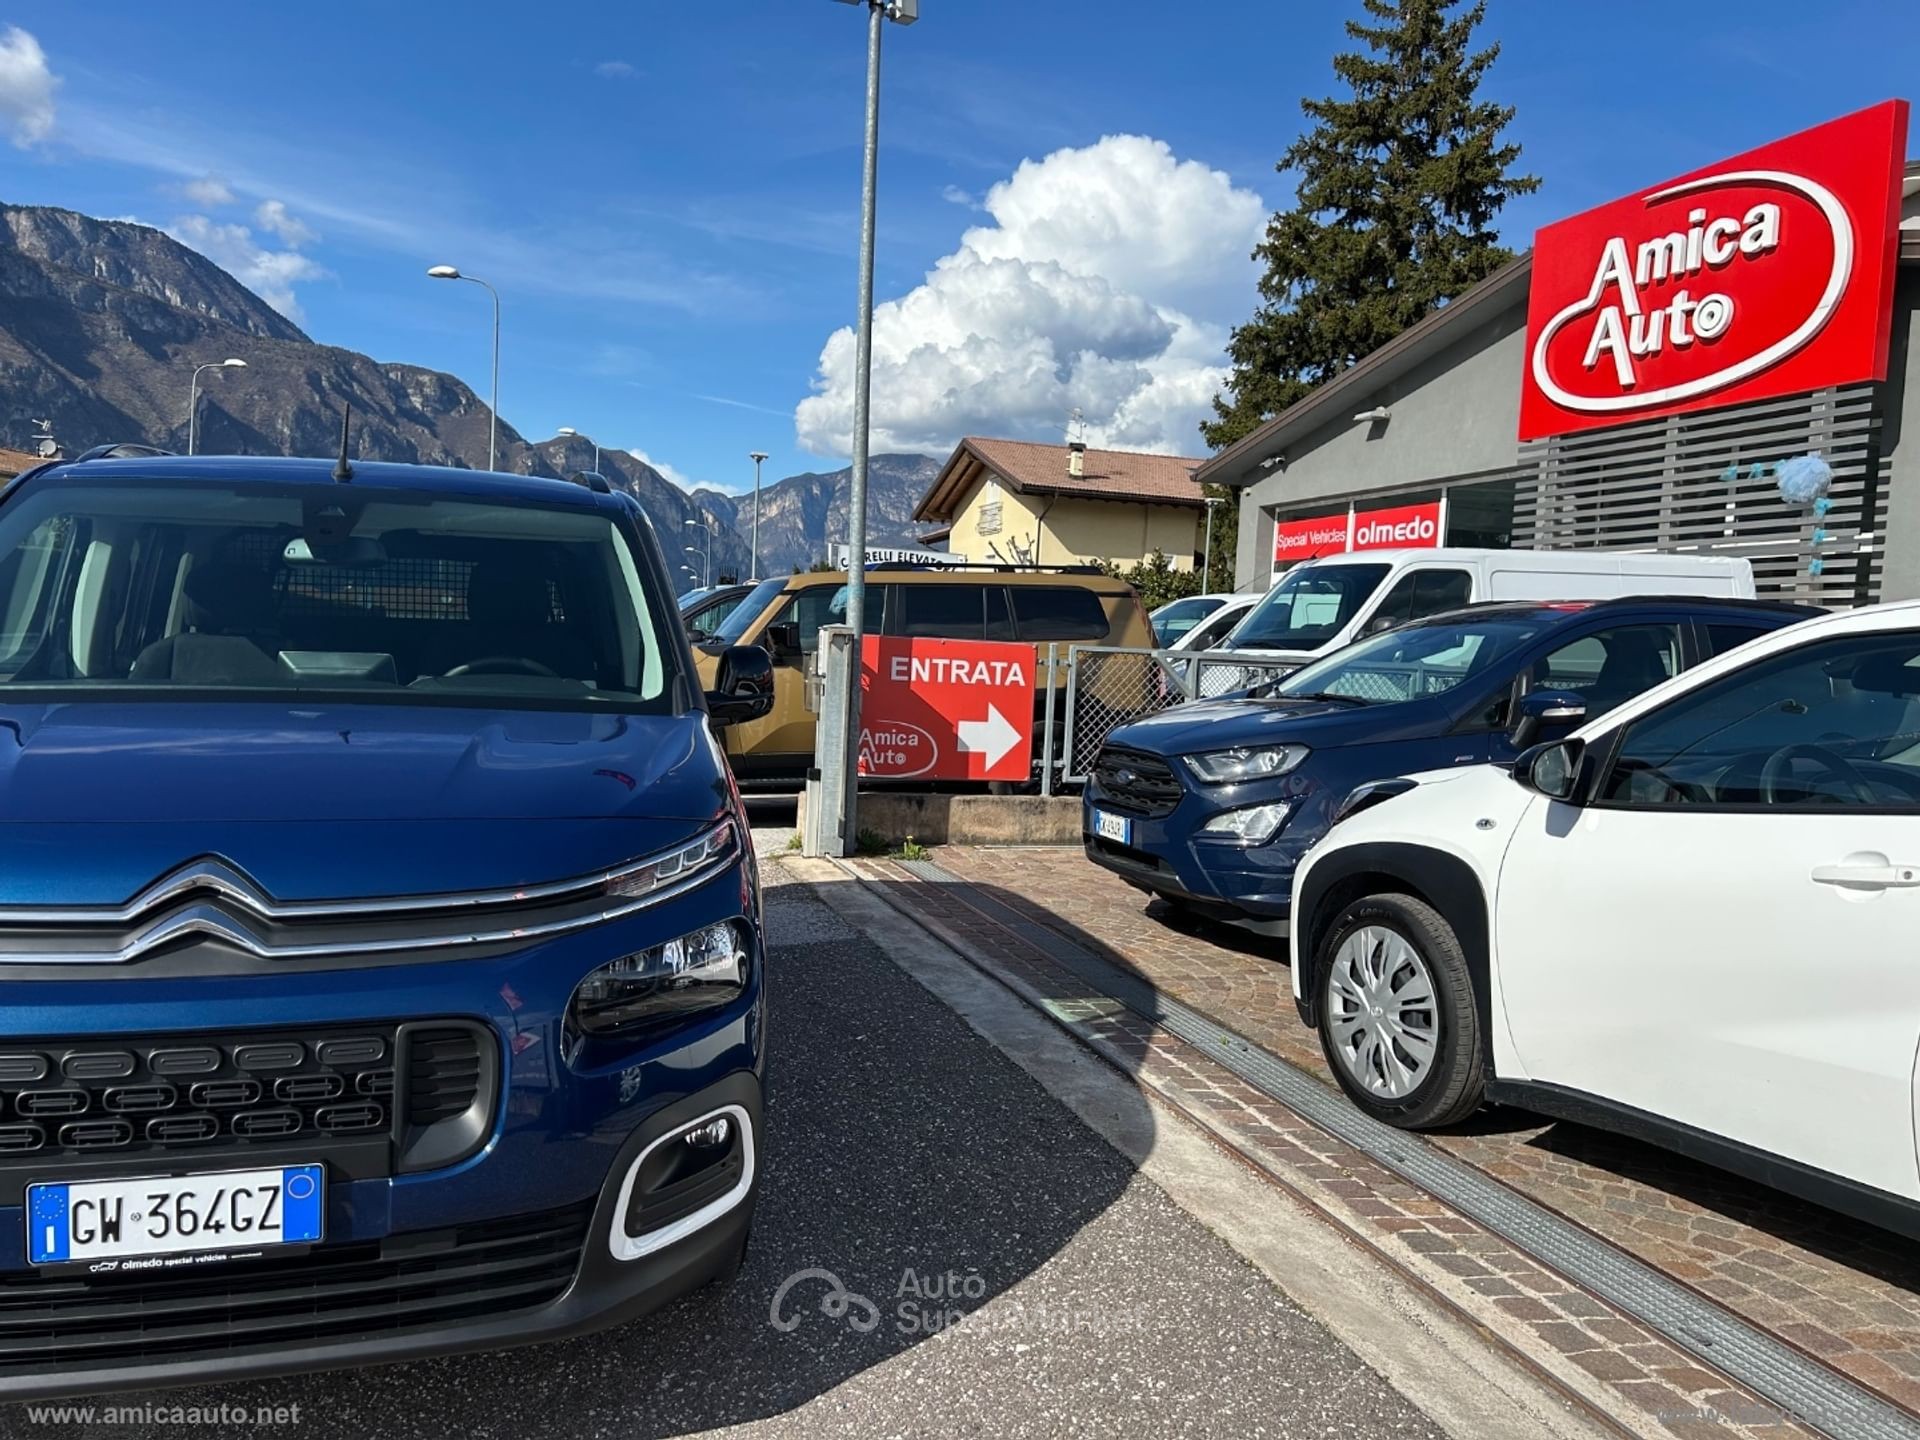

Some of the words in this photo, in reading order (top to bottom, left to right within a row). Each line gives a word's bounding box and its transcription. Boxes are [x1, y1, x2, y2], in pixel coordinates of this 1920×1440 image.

[1597, 202, 1781, 316] Amica
[1582, 290, 1735, 386] Auto
[1277, 531, 1307, 551] Special
[1309, 528, 1347, 545] Vehicles
[1356, 515, 1435, 545] olmedo
[841, 551, 893, 568] CRELLI
[890, 656, 1026, 687] ENTRATA
[858, 728, 919, 752] Amica
[859, 748, 907, 772] Auto
[72, 1198, 123, 1245] GW
[147, 1185, 281, 1239] 364GZ
[121, 1257, 163, 1270] olmedo
[164, 1256, 193, 1267] special
[195, 1253, 227, 1264] vehicles
